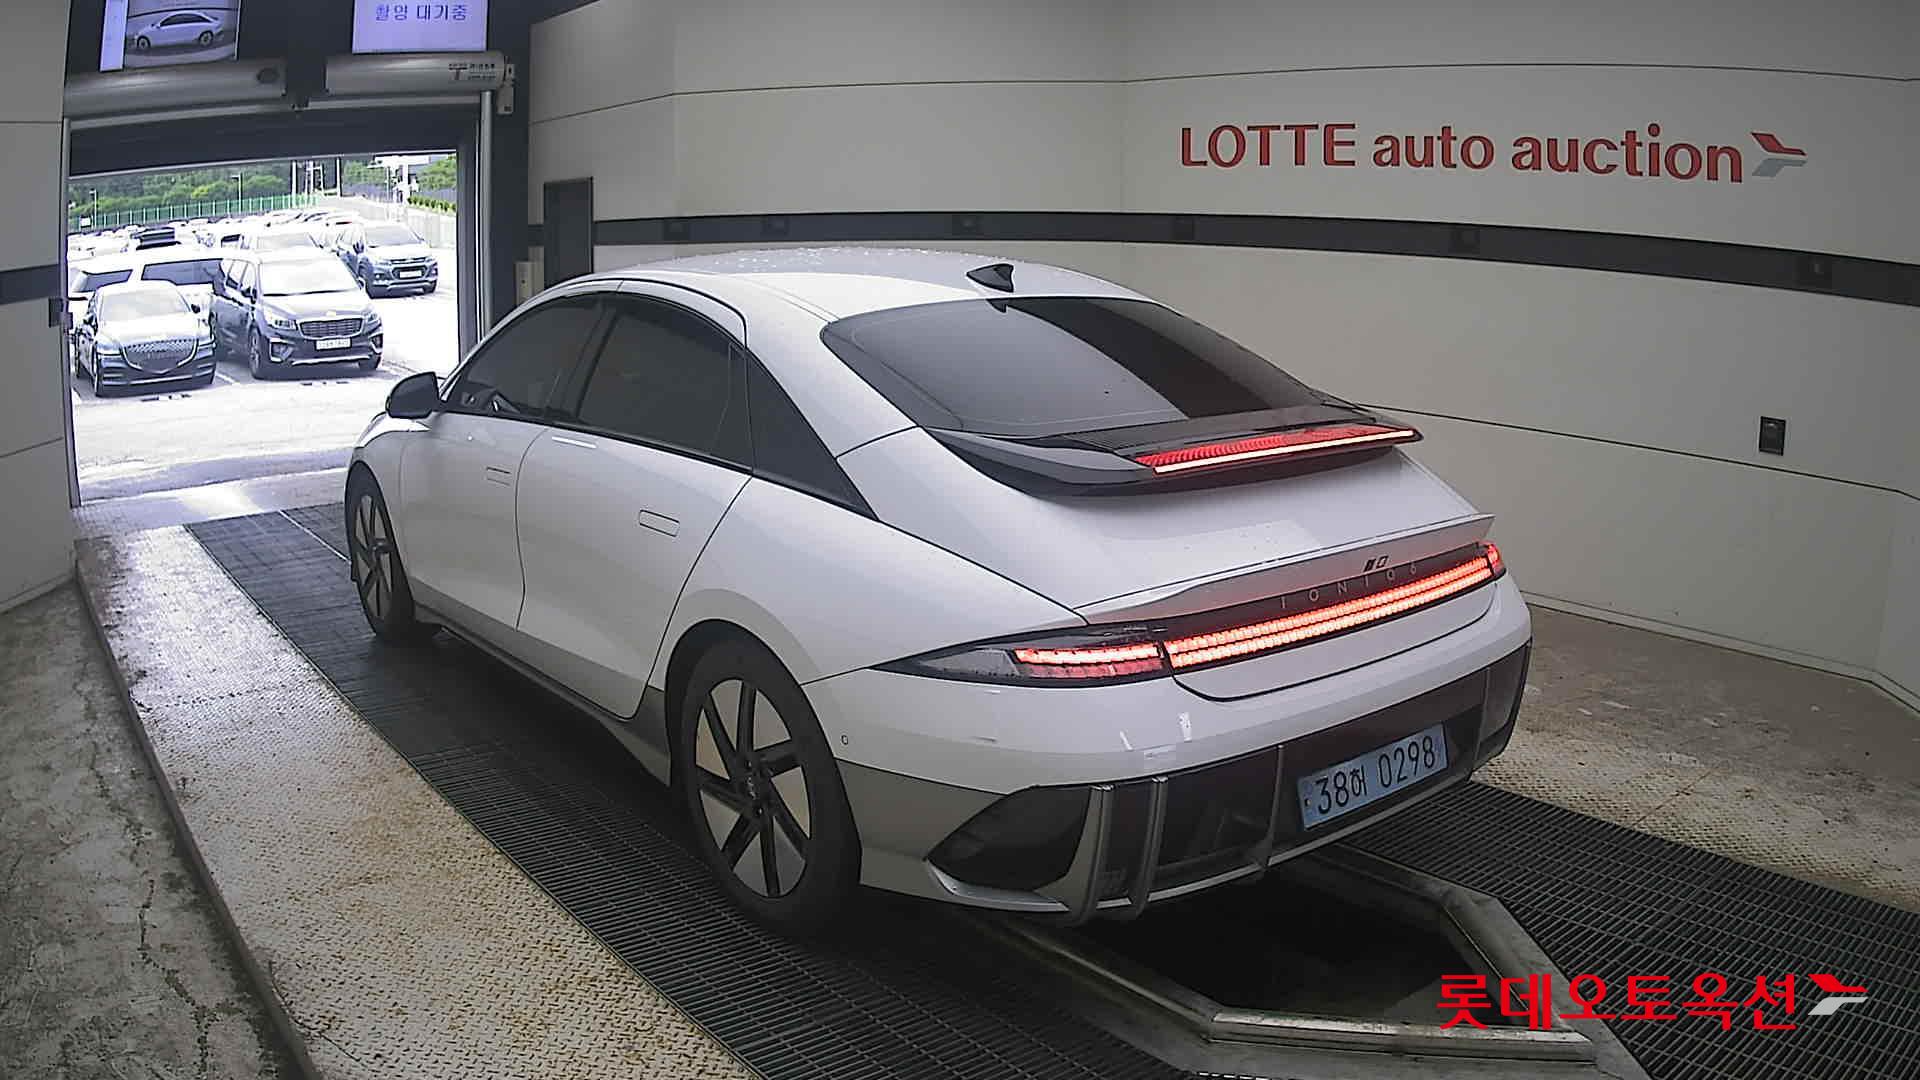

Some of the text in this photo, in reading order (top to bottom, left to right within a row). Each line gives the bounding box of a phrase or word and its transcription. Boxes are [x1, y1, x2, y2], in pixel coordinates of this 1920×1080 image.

[416, 4, 467, 21] 대기중
[1181, 122, 1745, 184] LOTTE auto auction
[1315, 735, 1436, 815] 38허 0298
